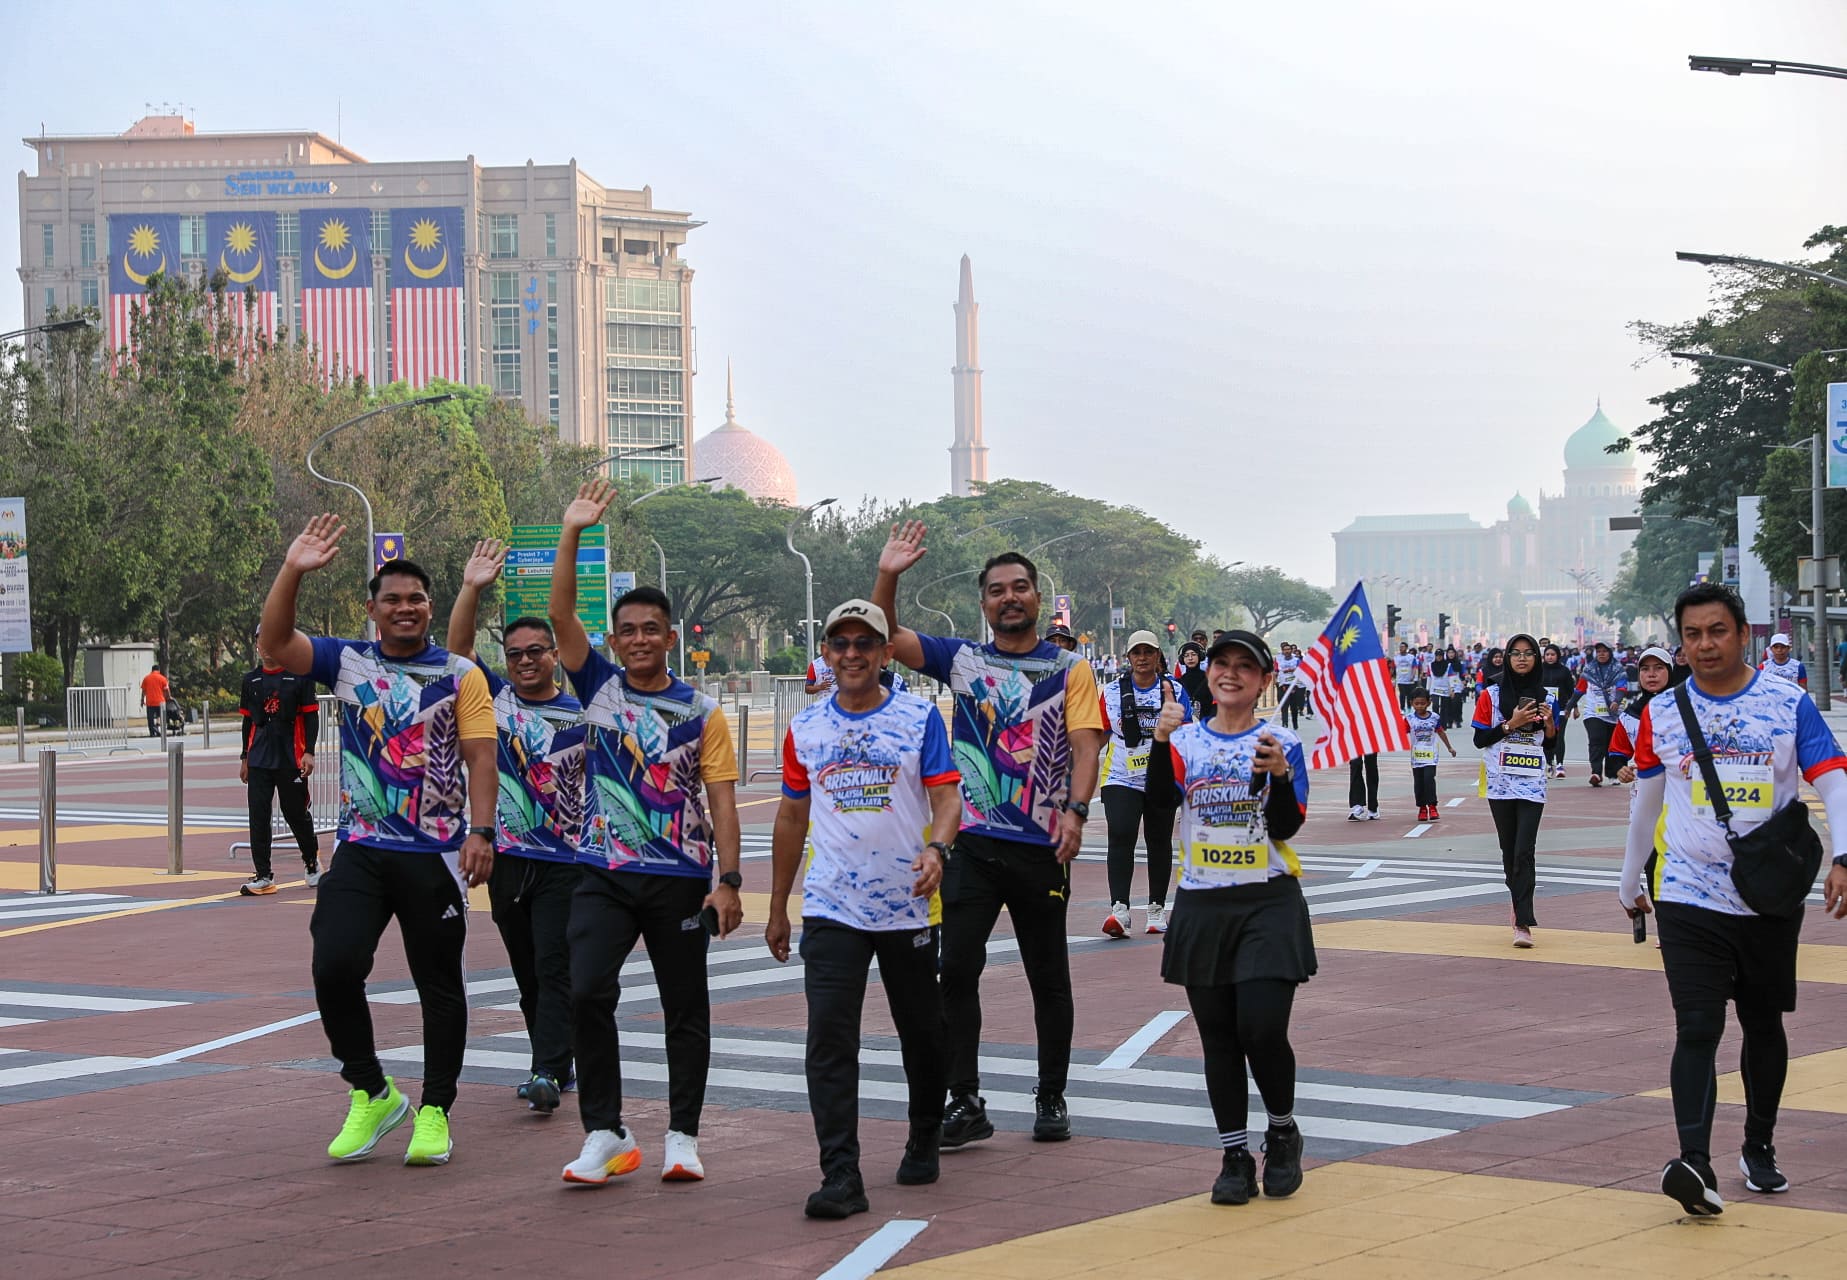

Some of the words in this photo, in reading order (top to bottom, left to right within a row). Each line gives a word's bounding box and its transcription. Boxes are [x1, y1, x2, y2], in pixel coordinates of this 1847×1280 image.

[1506, 755, 1540, 767] 20008
[824, 768, 894, 790] BRISKWALK
[1704, 787, 1761, 802] 1224
[1200, 805, 1232, 815] MALAYSIA
[1202, 848, 1256, 865] 10225
